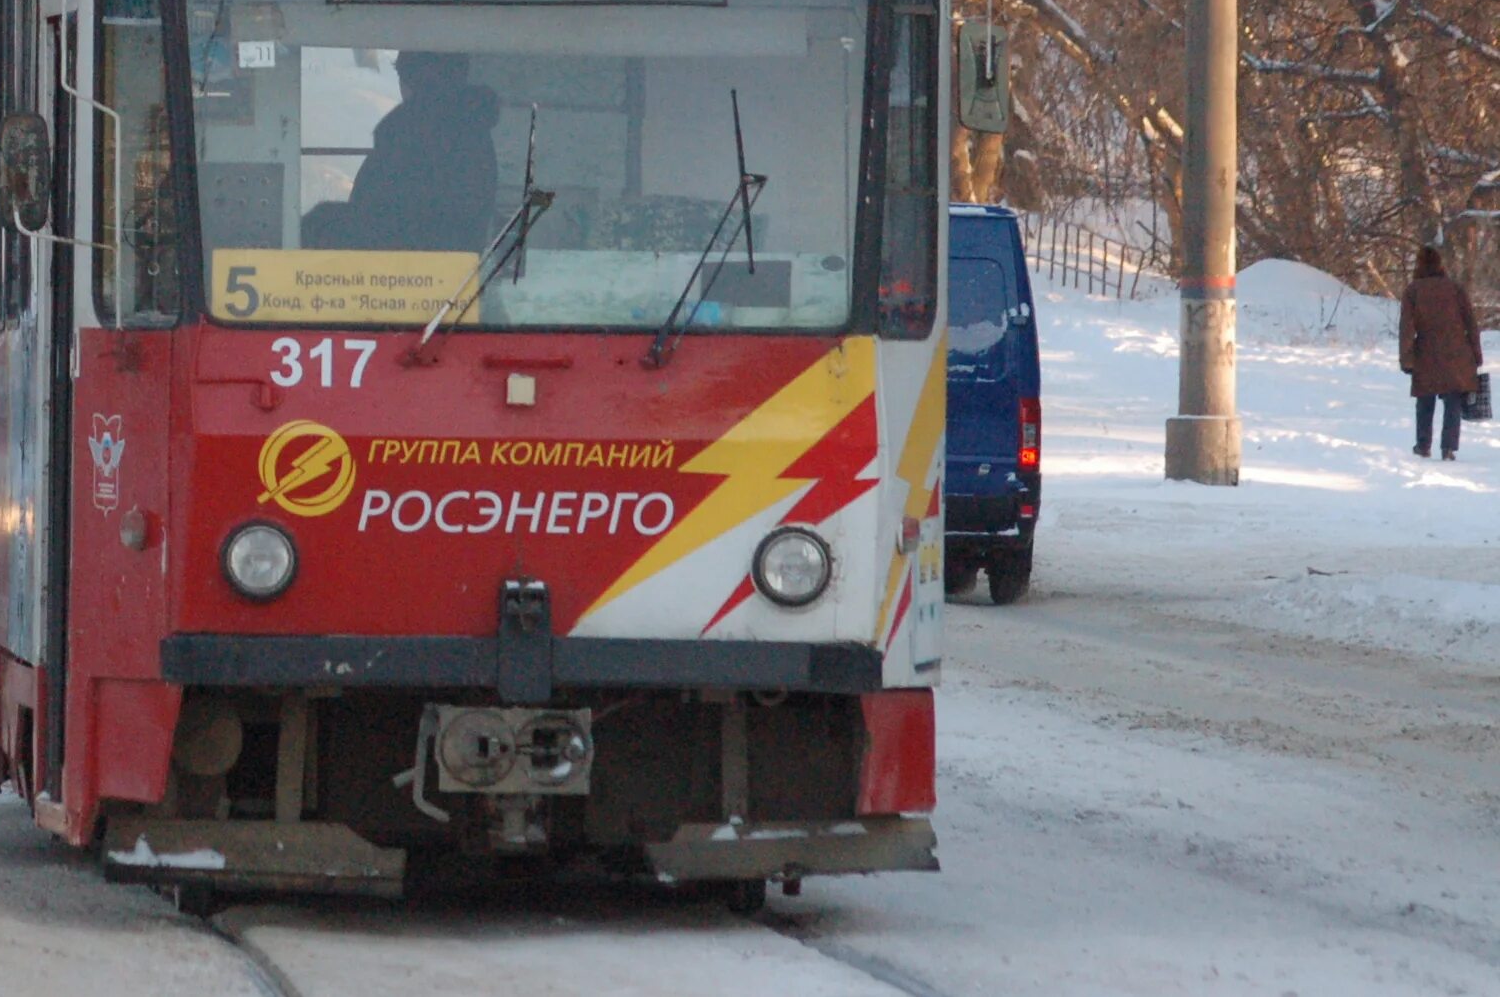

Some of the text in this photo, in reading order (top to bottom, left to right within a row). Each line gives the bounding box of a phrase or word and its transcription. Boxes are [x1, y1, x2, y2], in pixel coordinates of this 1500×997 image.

[224, 266, 260, 318] 5
[295, 270, 365, 287] Красный
[370, 273, 434, 289] перекоп
[269, 337, 378, 388] 317
[367, 438, 676, 469] ГРУППА КОМПАНИЙ
[357, 489, 675, 537] РОСЭНЕРГО
